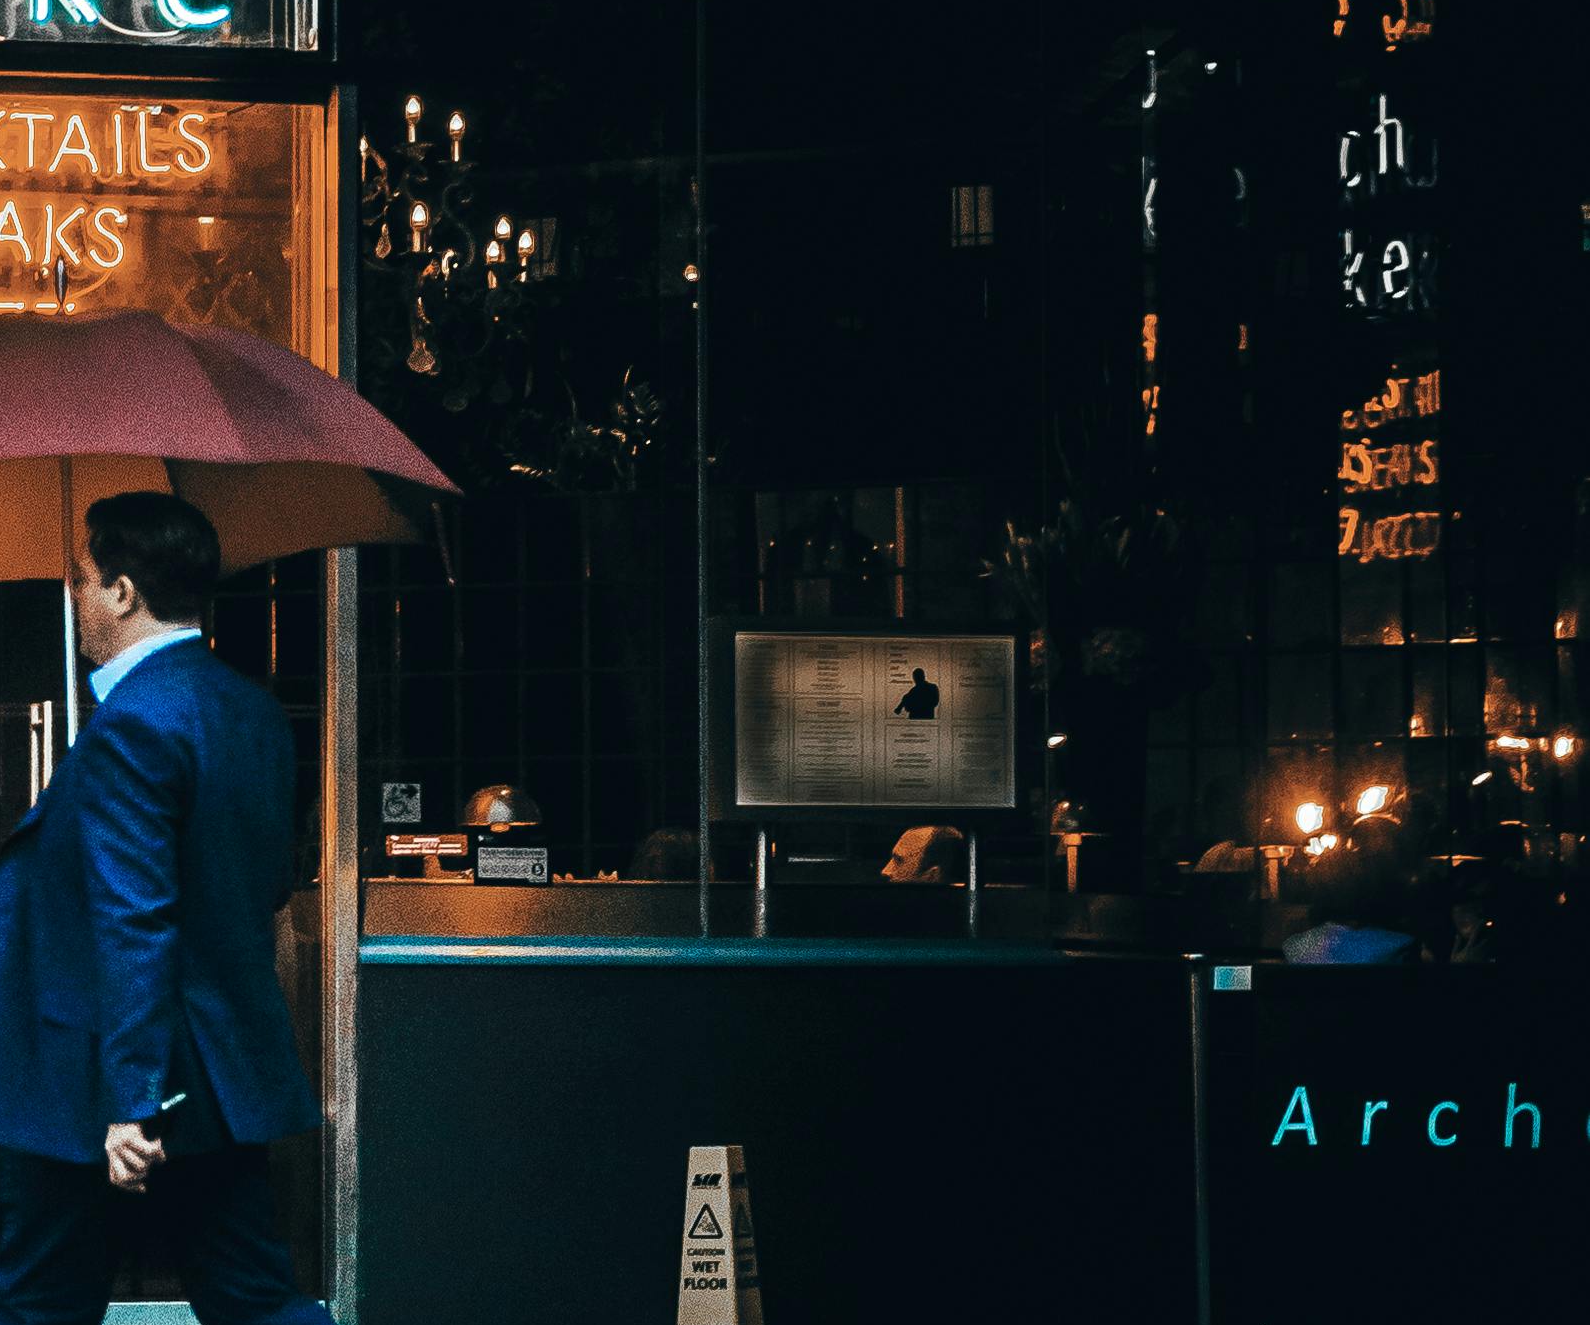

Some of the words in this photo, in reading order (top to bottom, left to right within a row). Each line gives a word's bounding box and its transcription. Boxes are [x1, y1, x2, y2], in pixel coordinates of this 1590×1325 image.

[1271, 1082, 1590, 1150] Arch
[686, 1247, 726, 1257] CAUTION
[691, 1260, 721, 1274] WET
[683, 1277, 728, 1291] FLOOR
